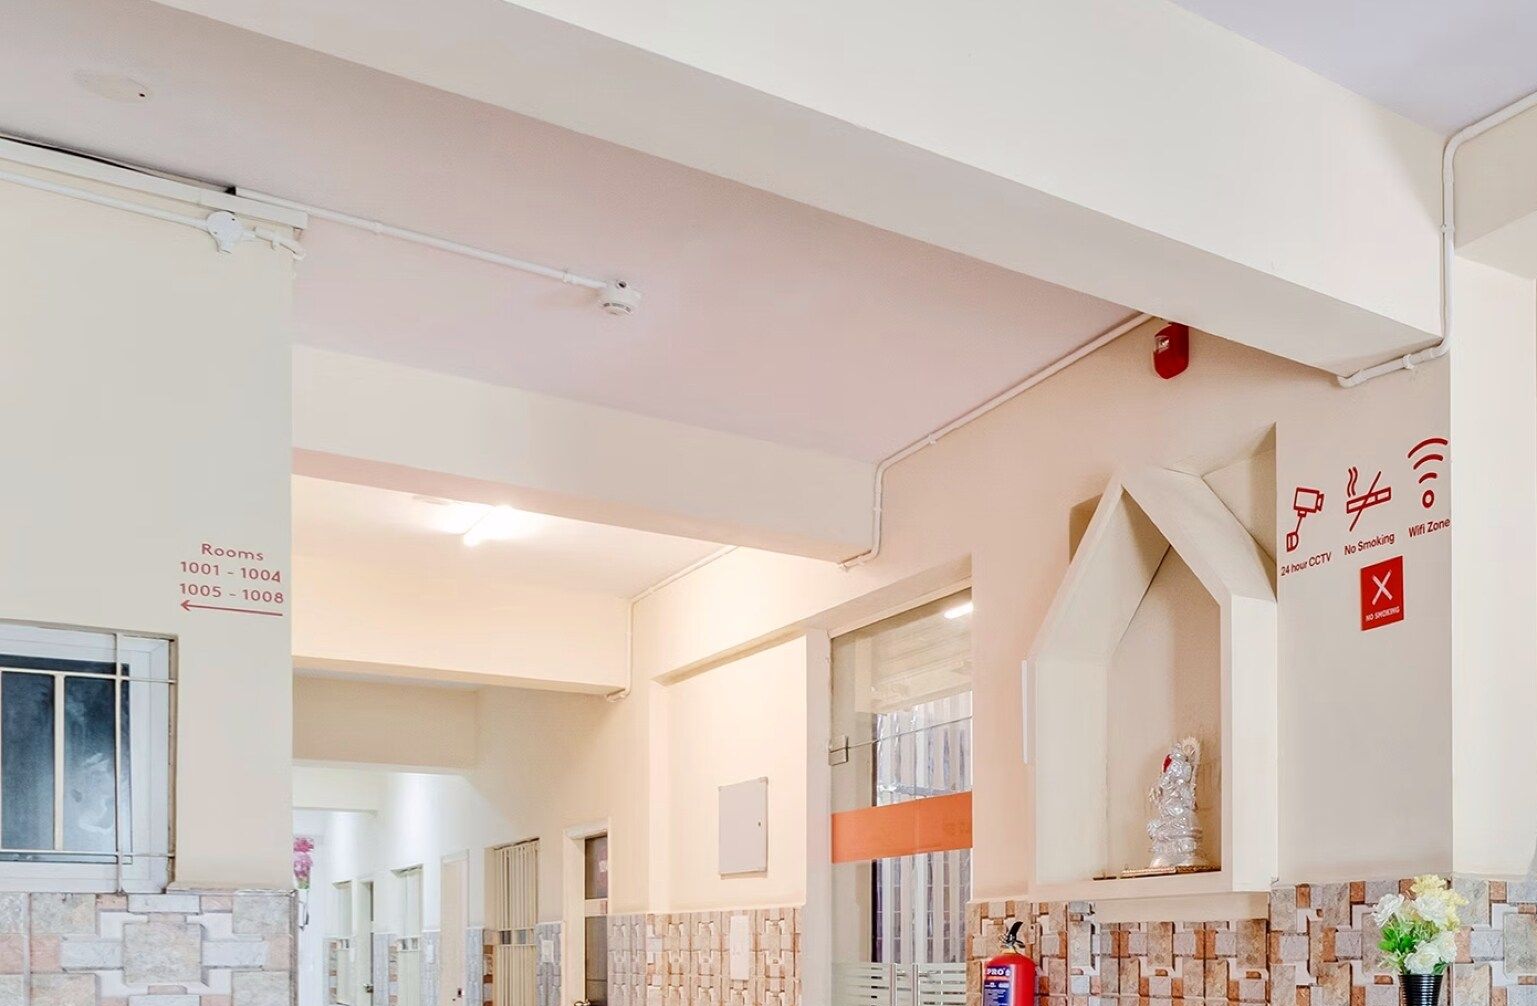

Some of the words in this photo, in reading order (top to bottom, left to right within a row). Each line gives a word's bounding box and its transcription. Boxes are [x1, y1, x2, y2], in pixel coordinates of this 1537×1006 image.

[1408, 523, 1426, 538] Wifi
[1427, 518, 1451, 533] Zone
[201, 543, 264, 561] Rooms
[1344, 542, 1357, 556] No
[1357, 532, 1396, 553] Smoking
[180, 561, 220, 576] 1001
[240, 567, 281, 583] 1004
[1280, 564, 1291, 577] 24
[1291, 559, 1308, 574] hour
[1308, 552, 1332, 568] CCTV
[179, 583, 222, 598] 1005
[242, 589, 284, 604] 1008
